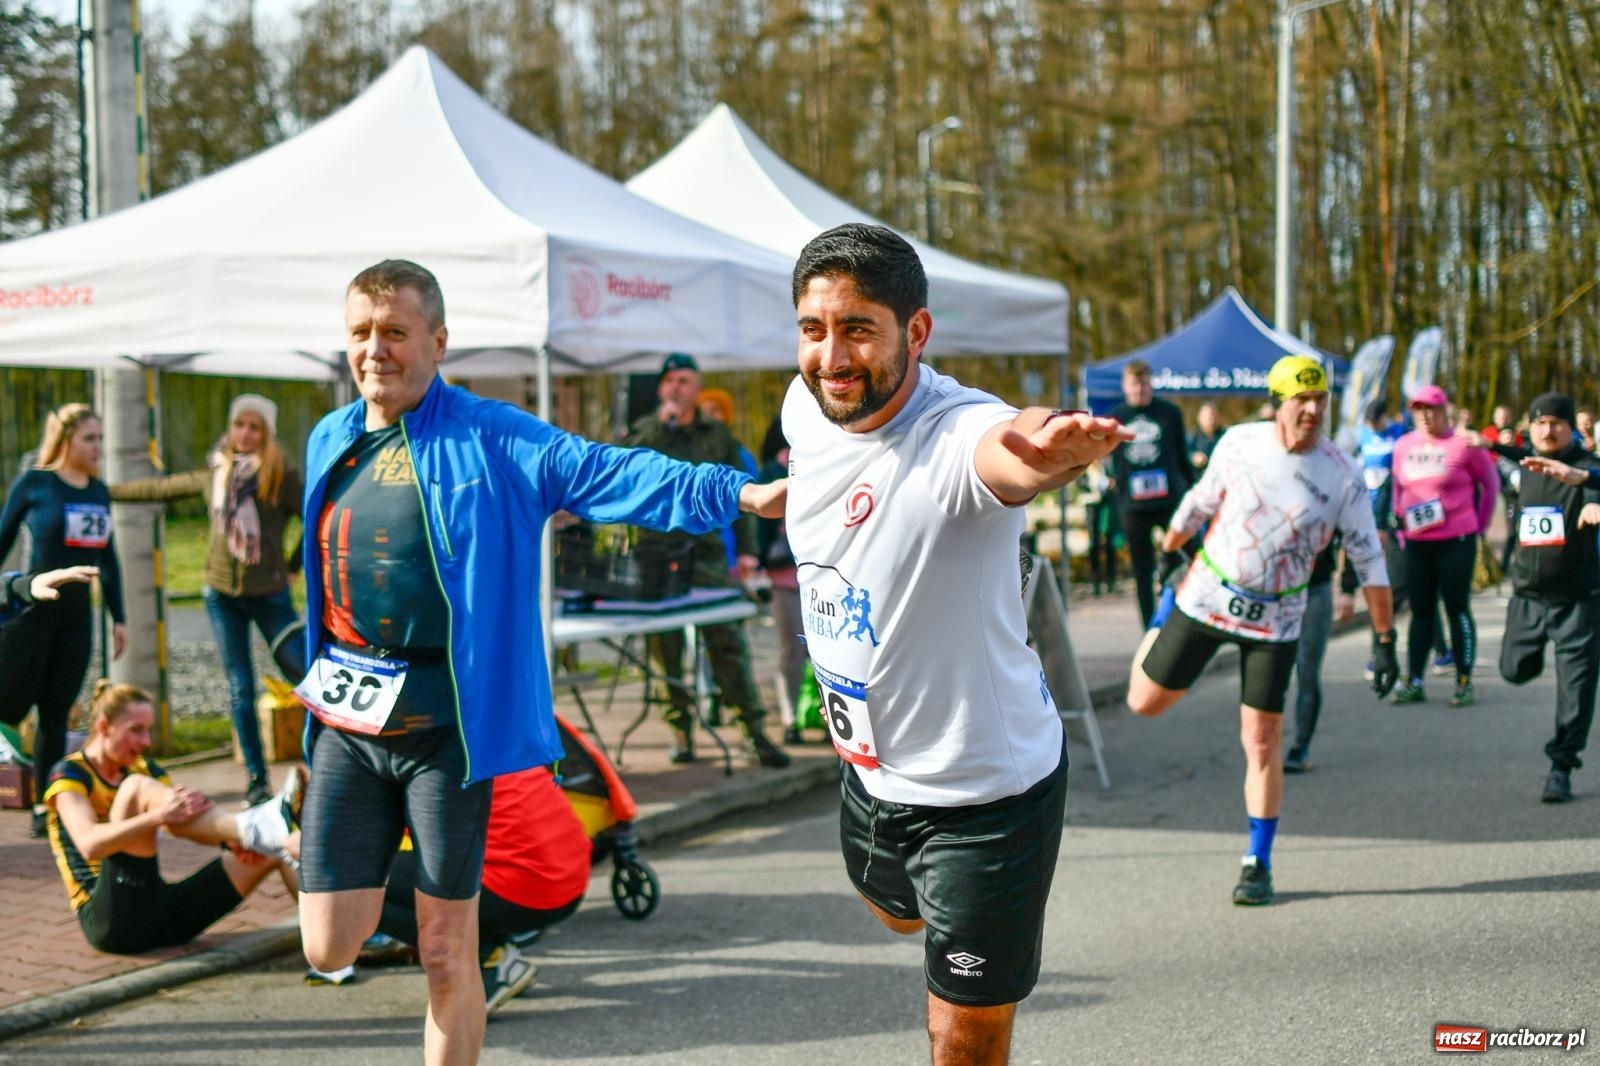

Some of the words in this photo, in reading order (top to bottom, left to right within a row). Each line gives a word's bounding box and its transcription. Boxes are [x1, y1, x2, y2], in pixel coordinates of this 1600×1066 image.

[1204, 367, 1233, 389] do
[371, 463, 417, 482] TEA
[1528, 516, 1552, 535] 50
[809, 588, 836, 617] Run
[1228, 596, 1265, 621] 68
[322, 669, 382, 712] 30
[950, 967, 983, 977] umbro
